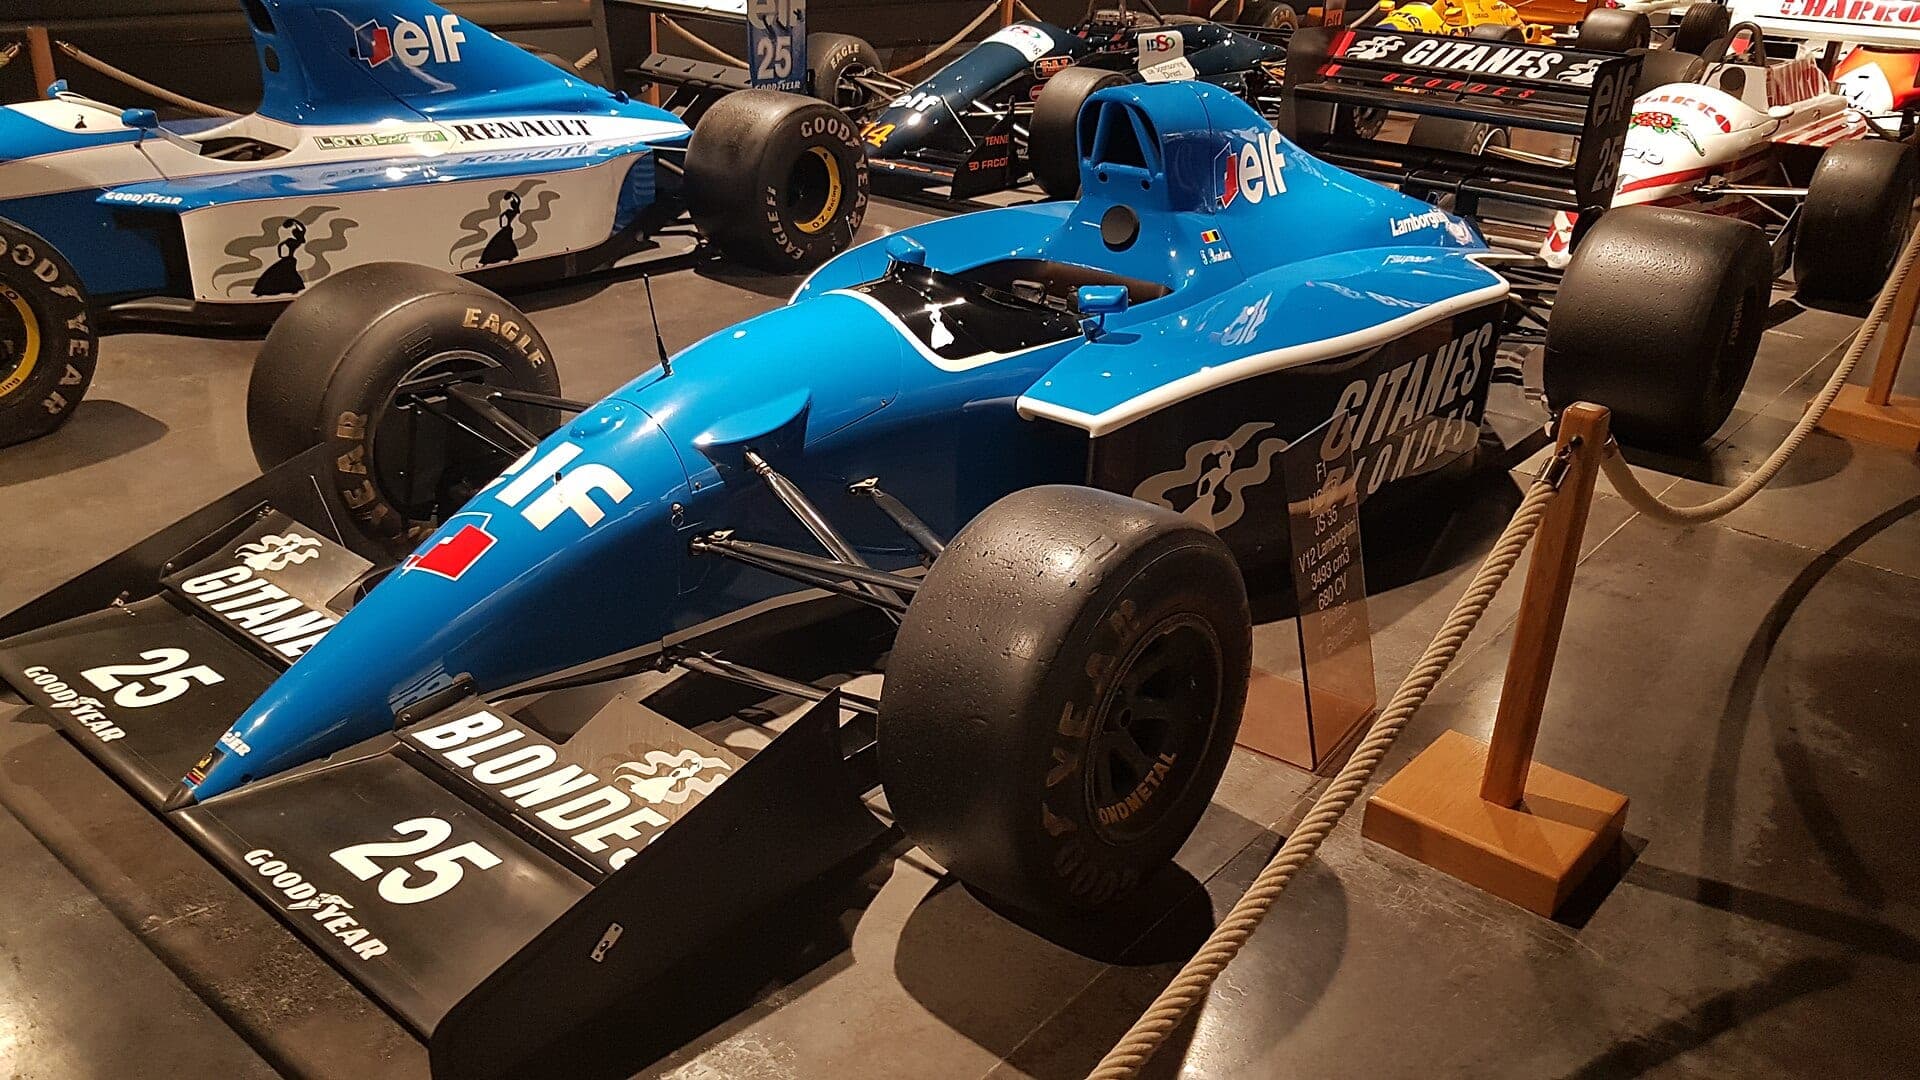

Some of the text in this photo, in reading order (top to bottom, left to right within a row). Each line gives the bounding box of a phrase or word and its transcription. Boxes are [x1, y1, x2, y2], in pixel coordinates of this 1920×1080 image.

[393, 14, 466, 67] elf
[757, 35, 793, 80] 25
[830, 43, 861, 70] EAGLE
[1402, 39, 1564, 79] GITANES
[889, 92, 943, 112] elf
[1382, 73, 1537, 99] BLONDES
[1592, 61, 1637, 128] elf
[451, 119, 593, 142] RENAULT
[861, 121, 896, 149] 14
[1238, 128, 1288, 205] elf
[1591, 136, 1624, 193] 25
[104, 190, 183, 205] GOODYEAR
[767, 210, 804, 260] EAGLE
[462, 307, 546, 369] EAGLE
[1320, 322, 1493, 462] GITANES
[1327, 504, 1338, 526] 35
[1298, 547, 1317, 573] V12
[1311, 546, 1350, 590] 3493 cm3
[1318, 572, 1347, 610] 680 CV
[80, 648, 226, 708] 25
[23, 665, 126, 742] GOODYEAR
[329, 817, 503, 904] 25
[244, 849, 388, 960] GOODYEAR
